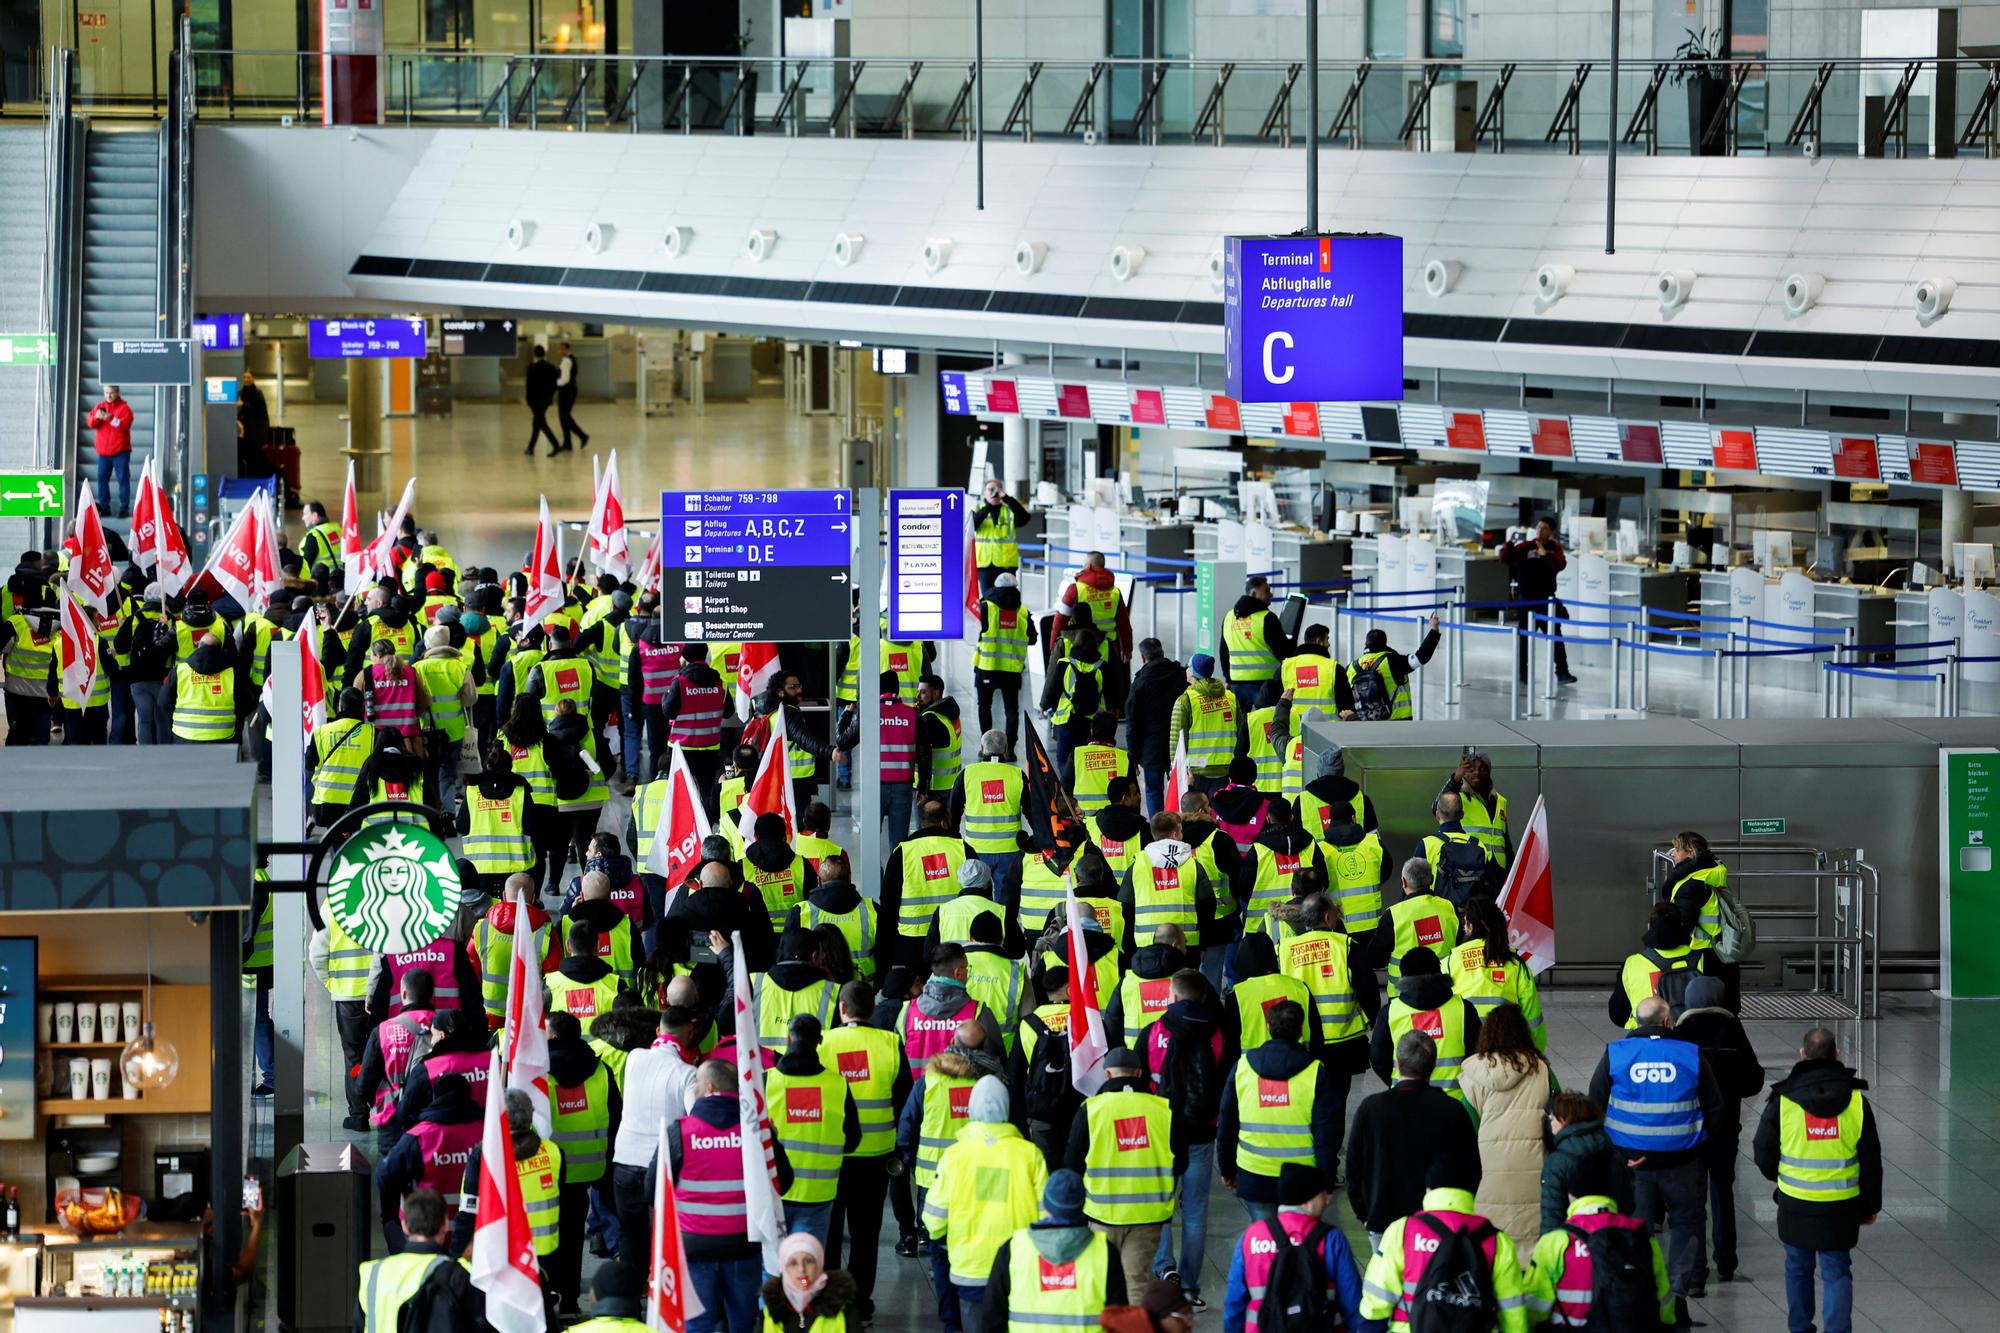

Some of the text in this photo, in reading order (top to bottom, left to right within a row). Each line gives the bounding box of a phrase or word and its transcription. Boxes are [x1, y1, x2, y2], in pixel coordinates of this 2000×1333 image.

[1261, 252, 1328, 265] Terminal 1
[1261, 276, 1332, 292] Abflughalle
[1261, 294, 1354, 310] Departures hall
[365, 321, 376, 336] C
[444, 321, 476, 330] condor
[1262, 331, 1295, 385] C
[704, 494, 733, 502] Schalter
[738, 493, 753, 503] 759
[761, 493, 778, 503] 798
[704, 503, 732, 512] Counter
[704, 519, 727, 529] Abflug
[901, 522, 931, 531] condor
[704, 529, 741, 538] Departures
[704, 545, 734, 553] Terminal
[704, 570, 736, 579] Toiletten
[704, 580, 728, 588] Toilets
[704, 596, 729, 605] Airport
[704, 605, 748, 614] Tours & Shop
[705, 621, 764, 630] Besucherzentrum
[732, 630, 756, 639] Center
[645, 645, 680, 657] komba
[560, 681, 579, 690] ver.di
[1298, 677, 1318, 686] ver.di
[686, 686, 719, 696] komba
[1200, 703, 1214, 711] GEHT
[879, 716, 909, 727] omba
[1084, 752, 1117, 760] ZUSAMMEN
[1086, 759, 1117, 769] GEHT MEHR
[388, 791, 408, 799] ver.di
[983, 791, 1004, 800] ver.di
[477, 799, 511, 809] GEHT MEHR
[1279, 861, 1300, 870] ver.di
[925, 866, 947, 876] ver.di
[755, 870, 792, 884] GEHT MEHR
[1155, 879, 1178, 887] ver.di
[610, 889, 635, 900] mba
[1418, 931, 1442, 941] ver.di
[1290, 940, 1330, 956] ZUSAMMEN
[395, 949, 446, 967] komba
[1292, 950, 1331, 966] GEHT MEHR
[569, 1004, 595, 1014] ver.di
[840, 1068, 868, 1079] ver.di
[1260, 1092, 1288, 1104] ver.di
[560, 1098, 586, 1110] ver.di
[788, 1107, 820, 1118] ver.di
[1808, 1124, 1837, 1137] ver.di
[690, 1132, 743, 1150] komb
[1117, 1134, 1146, 1147] ver.di
[528, 1156, 550, 1169] MEHR
[1041, 1273, 1075, 1286] ver.di
